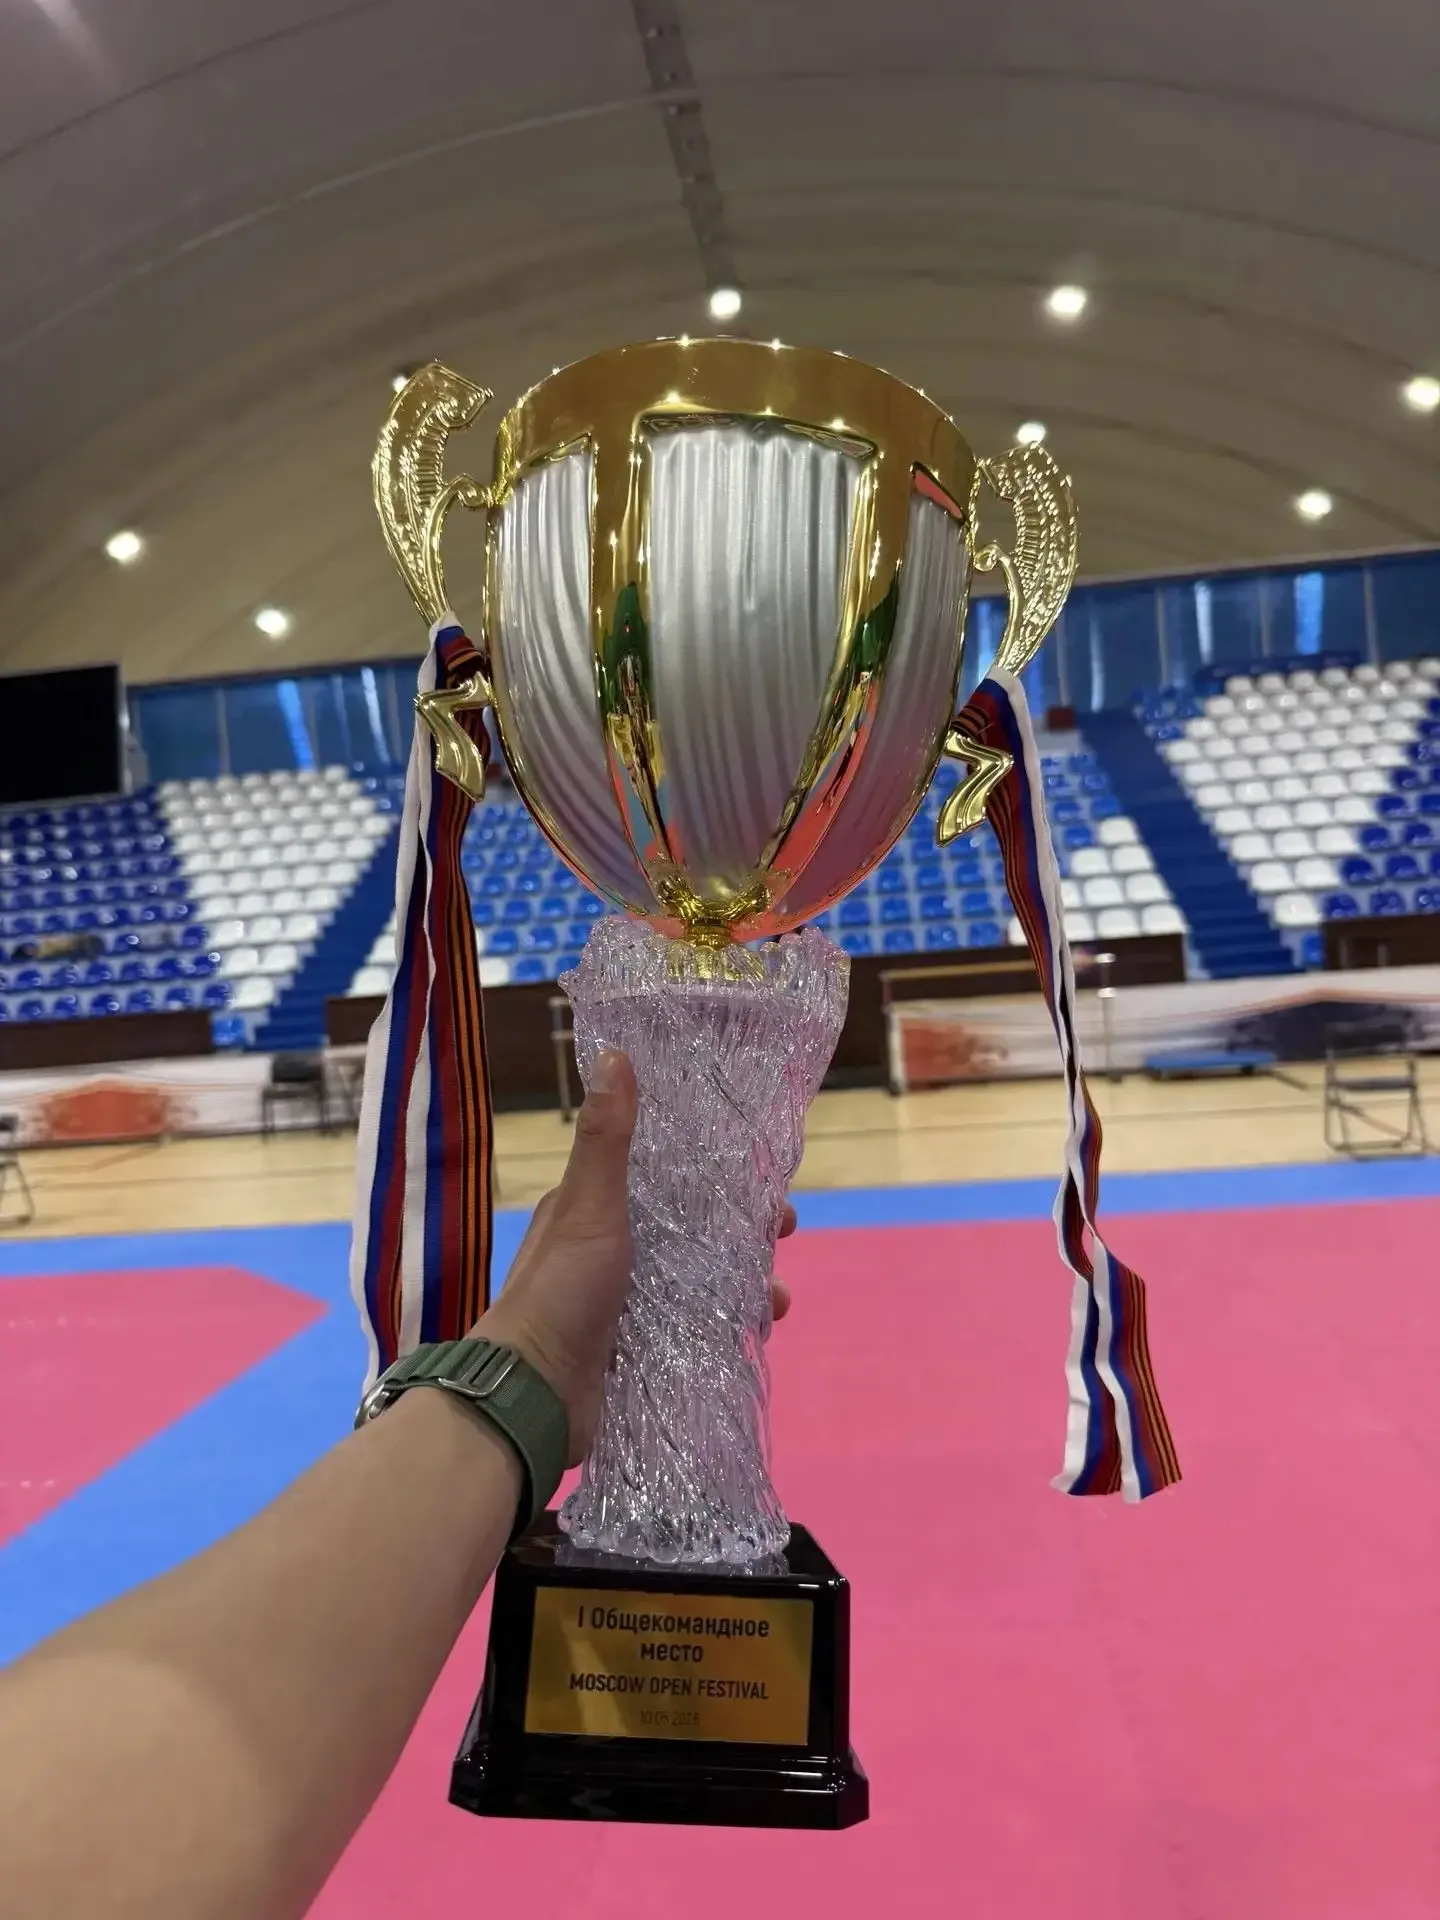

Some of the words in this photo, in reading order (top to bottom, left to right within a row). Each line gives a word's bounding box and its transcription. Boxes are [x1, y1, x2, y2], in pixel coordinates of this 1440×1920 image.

[592, 1607, 770, 1638] Общекомандное
[641, 1643, 703, 1662] место
[570, 1673, 645, 1693] MOSCOW
[650, 1677, 691, 1696] OPEN
[697, 1680, 768, 1699] FESTIVAL
